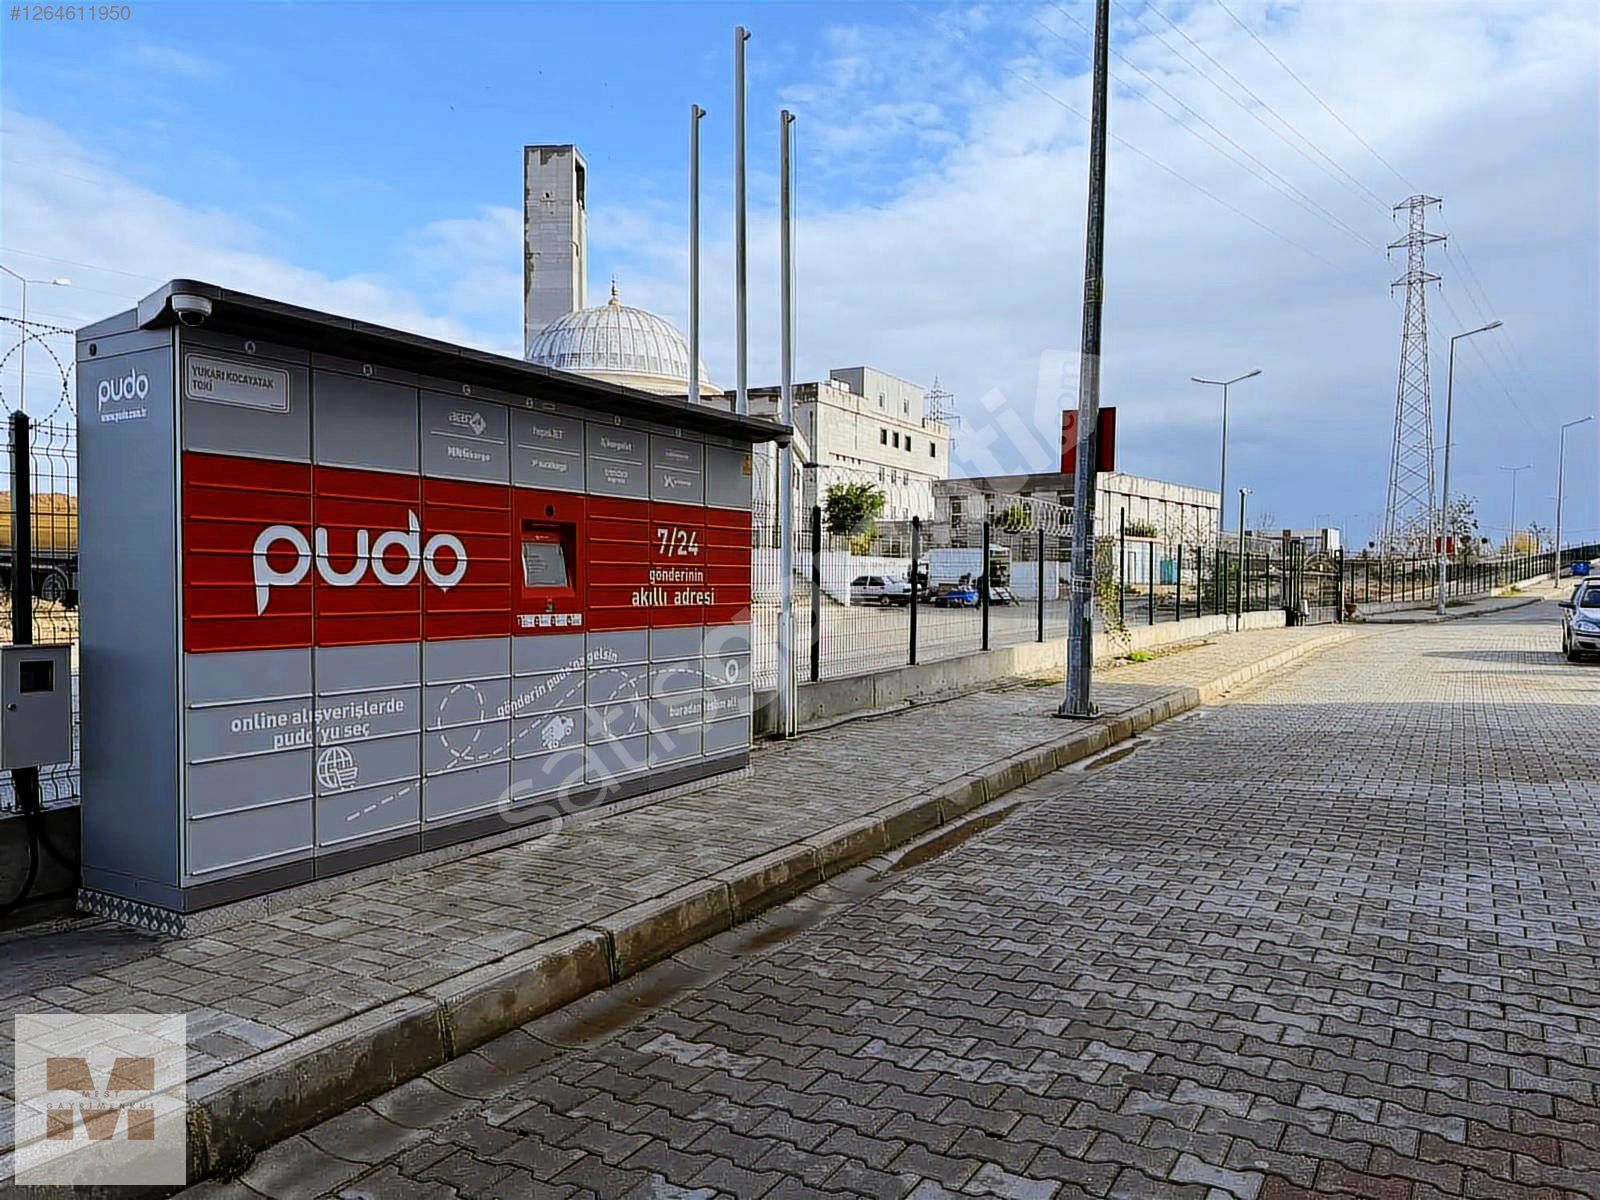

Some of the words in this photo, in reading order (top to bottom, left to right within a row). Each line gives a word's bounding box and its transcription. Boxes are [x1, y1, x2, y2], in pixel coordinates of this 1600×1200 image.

[192, 365, 225, 380] YUKARI
[98, 368, 149, 412] pudo
[657, 527, 699, 557] 7/24
[253, 508, 468, 617] pudo
[649, 567, 704, 585] gönderinin
[632, 587, 667, 607] akıllı
[674, 587, 715, 605] adresi
[496, 683, 547, 718] gönderin
[587, 647, 618, 665] gelsin
[231, 712, 288, 732] online
[343, 722, 370, 738] seç
